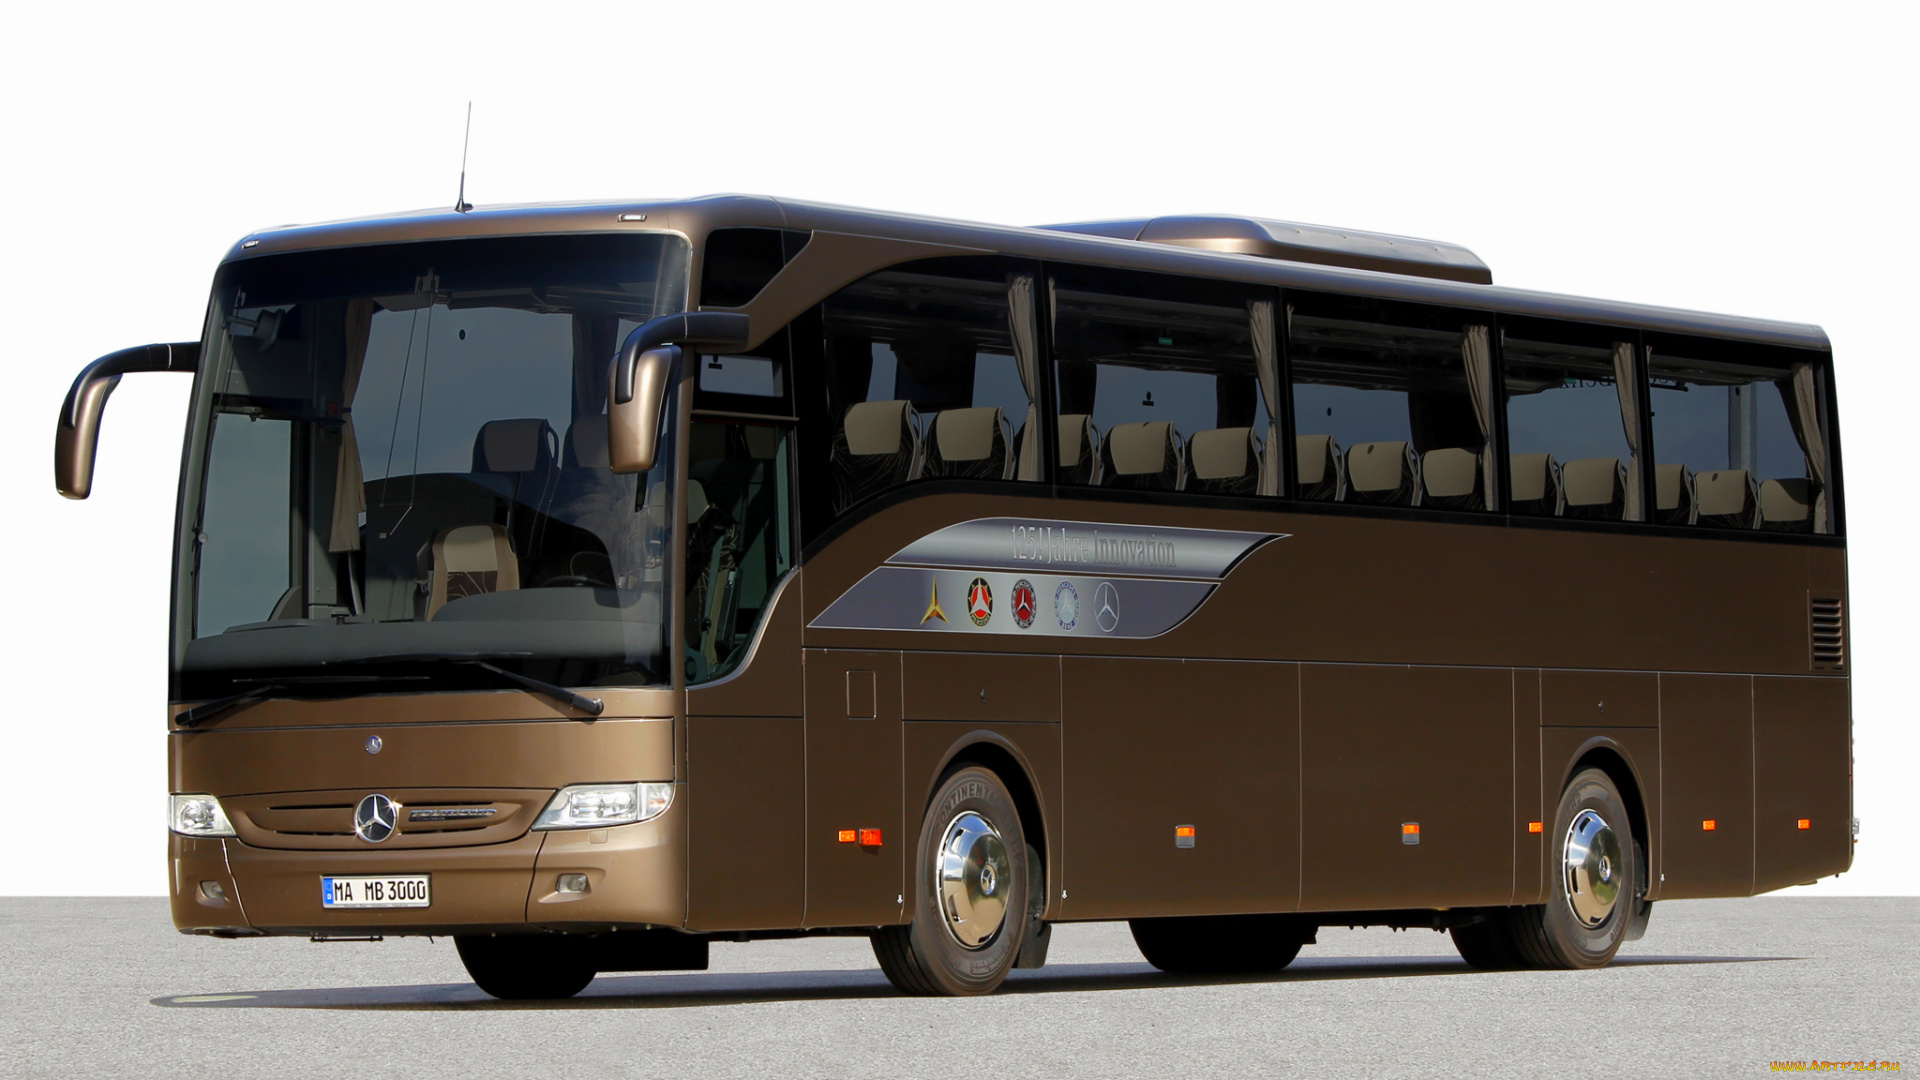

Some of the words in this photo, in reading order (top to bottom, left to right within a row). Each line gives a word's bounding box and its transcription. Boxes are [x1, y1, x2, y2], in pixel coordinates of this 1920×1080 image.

[1010, 525, 1043, 561] 125!
[1046, 526, 1089, 564] Jahre
[1093, 529, 1177, 567] Innovation
[334, 881, 353, 901] MA
[365, 881, 384, 901] MB
[387, 880, 426, 901] 3000
